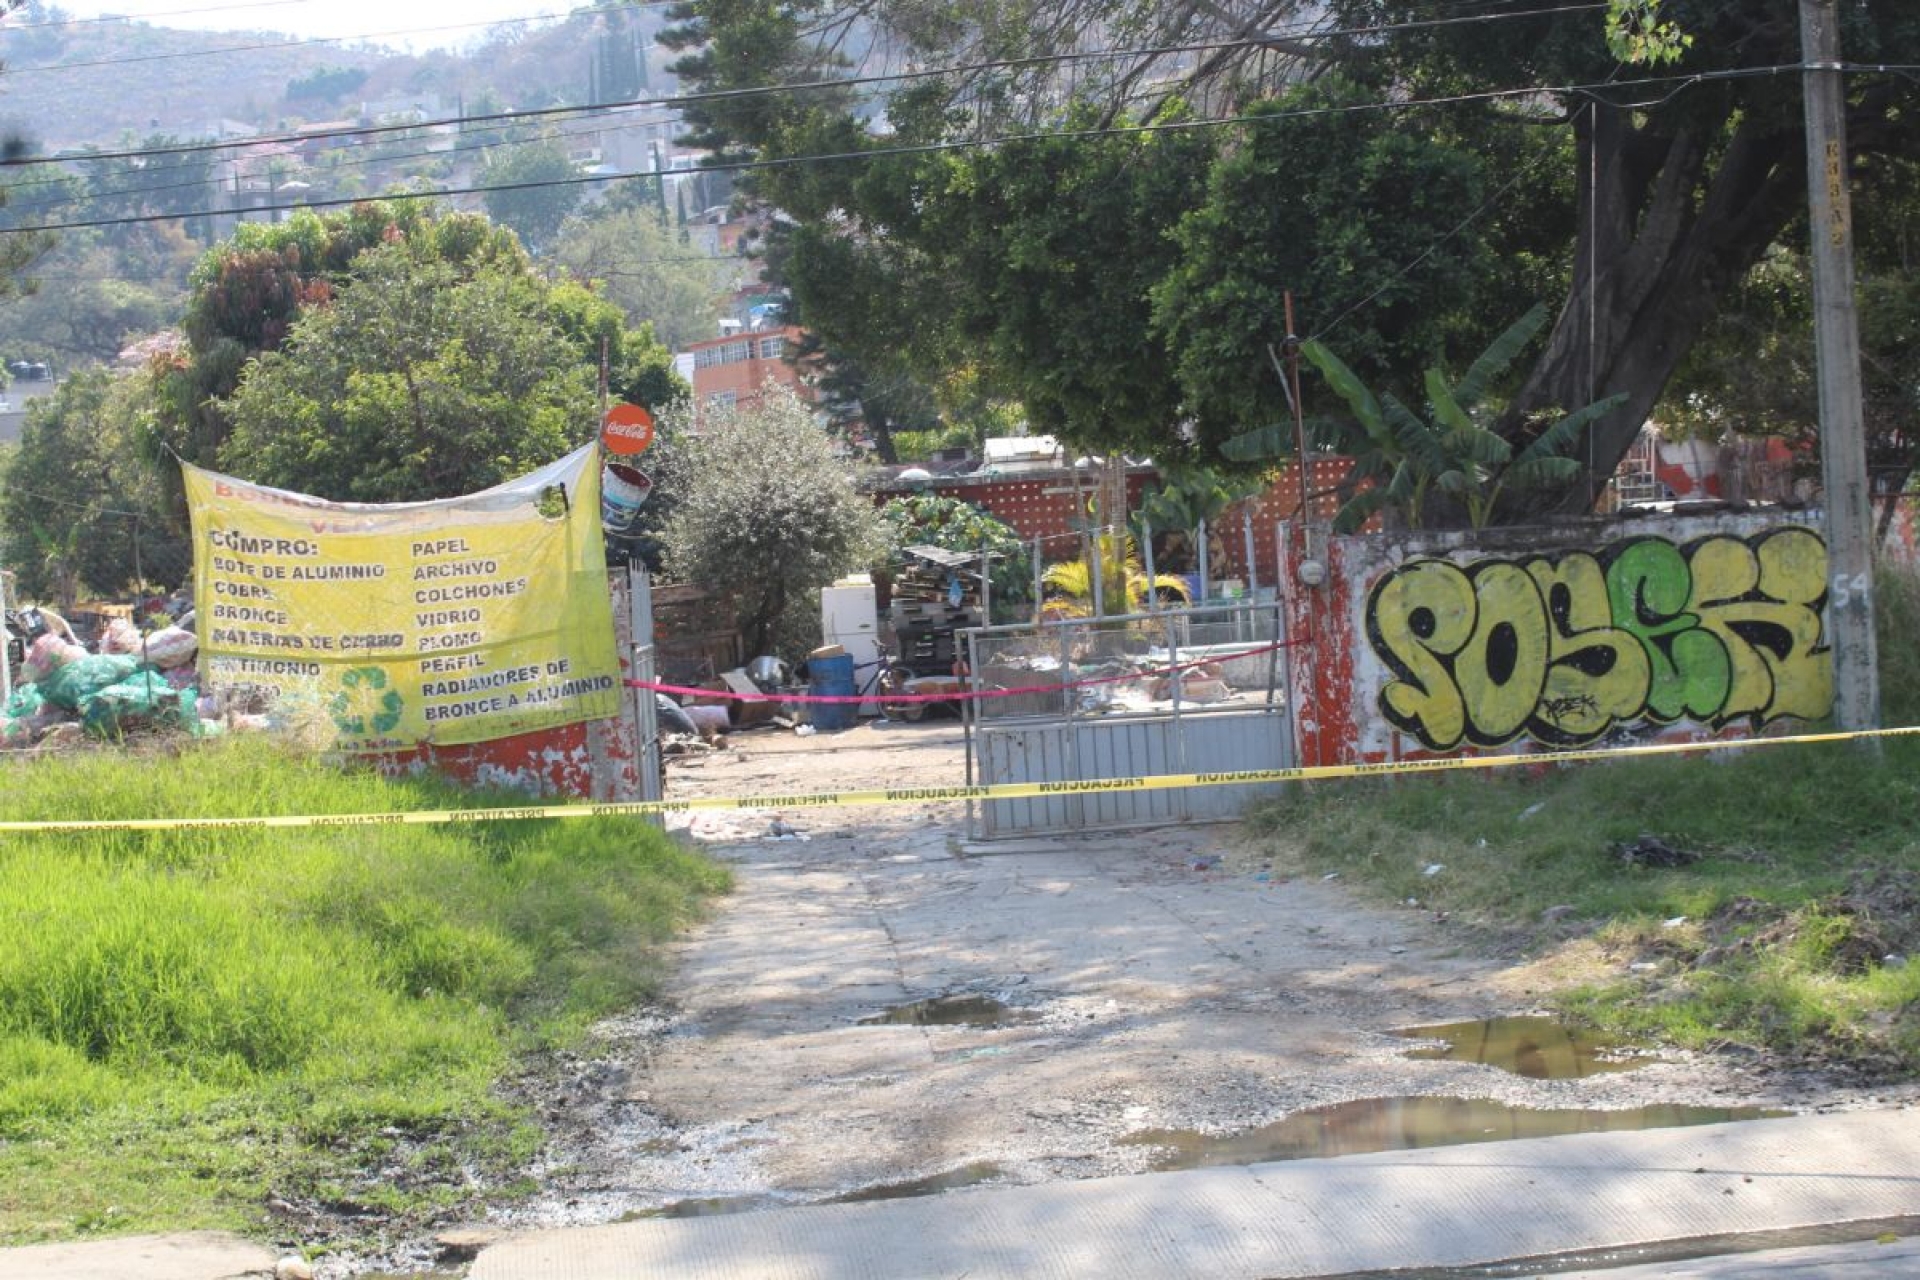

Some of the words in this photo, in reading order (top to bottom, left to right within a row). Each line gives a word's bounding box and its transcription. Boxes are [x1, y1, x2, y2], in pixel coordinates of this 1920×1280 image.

[212, 531, 318, 555] COMPRO:
[412, 539, 469, 557] PAPEL
[262, 566, 286, 579] DE
[292, 564, 385, 580] ALUMINIO
[414, 561, 497, 580] ARCHIVO
[415, 578, 526, 604] COLCHONES
[214, 604, 289, 625] BRONCE
[416, 609, 481, 628] VIDRIO
[418, 632, 481, 651] PLOMO
[420, 654, 485, 673] PERFIL
[546, 659, 569, 677] DE
[426, 698, 501, 721] BRONCE
[508, 695, 519, 708] A
